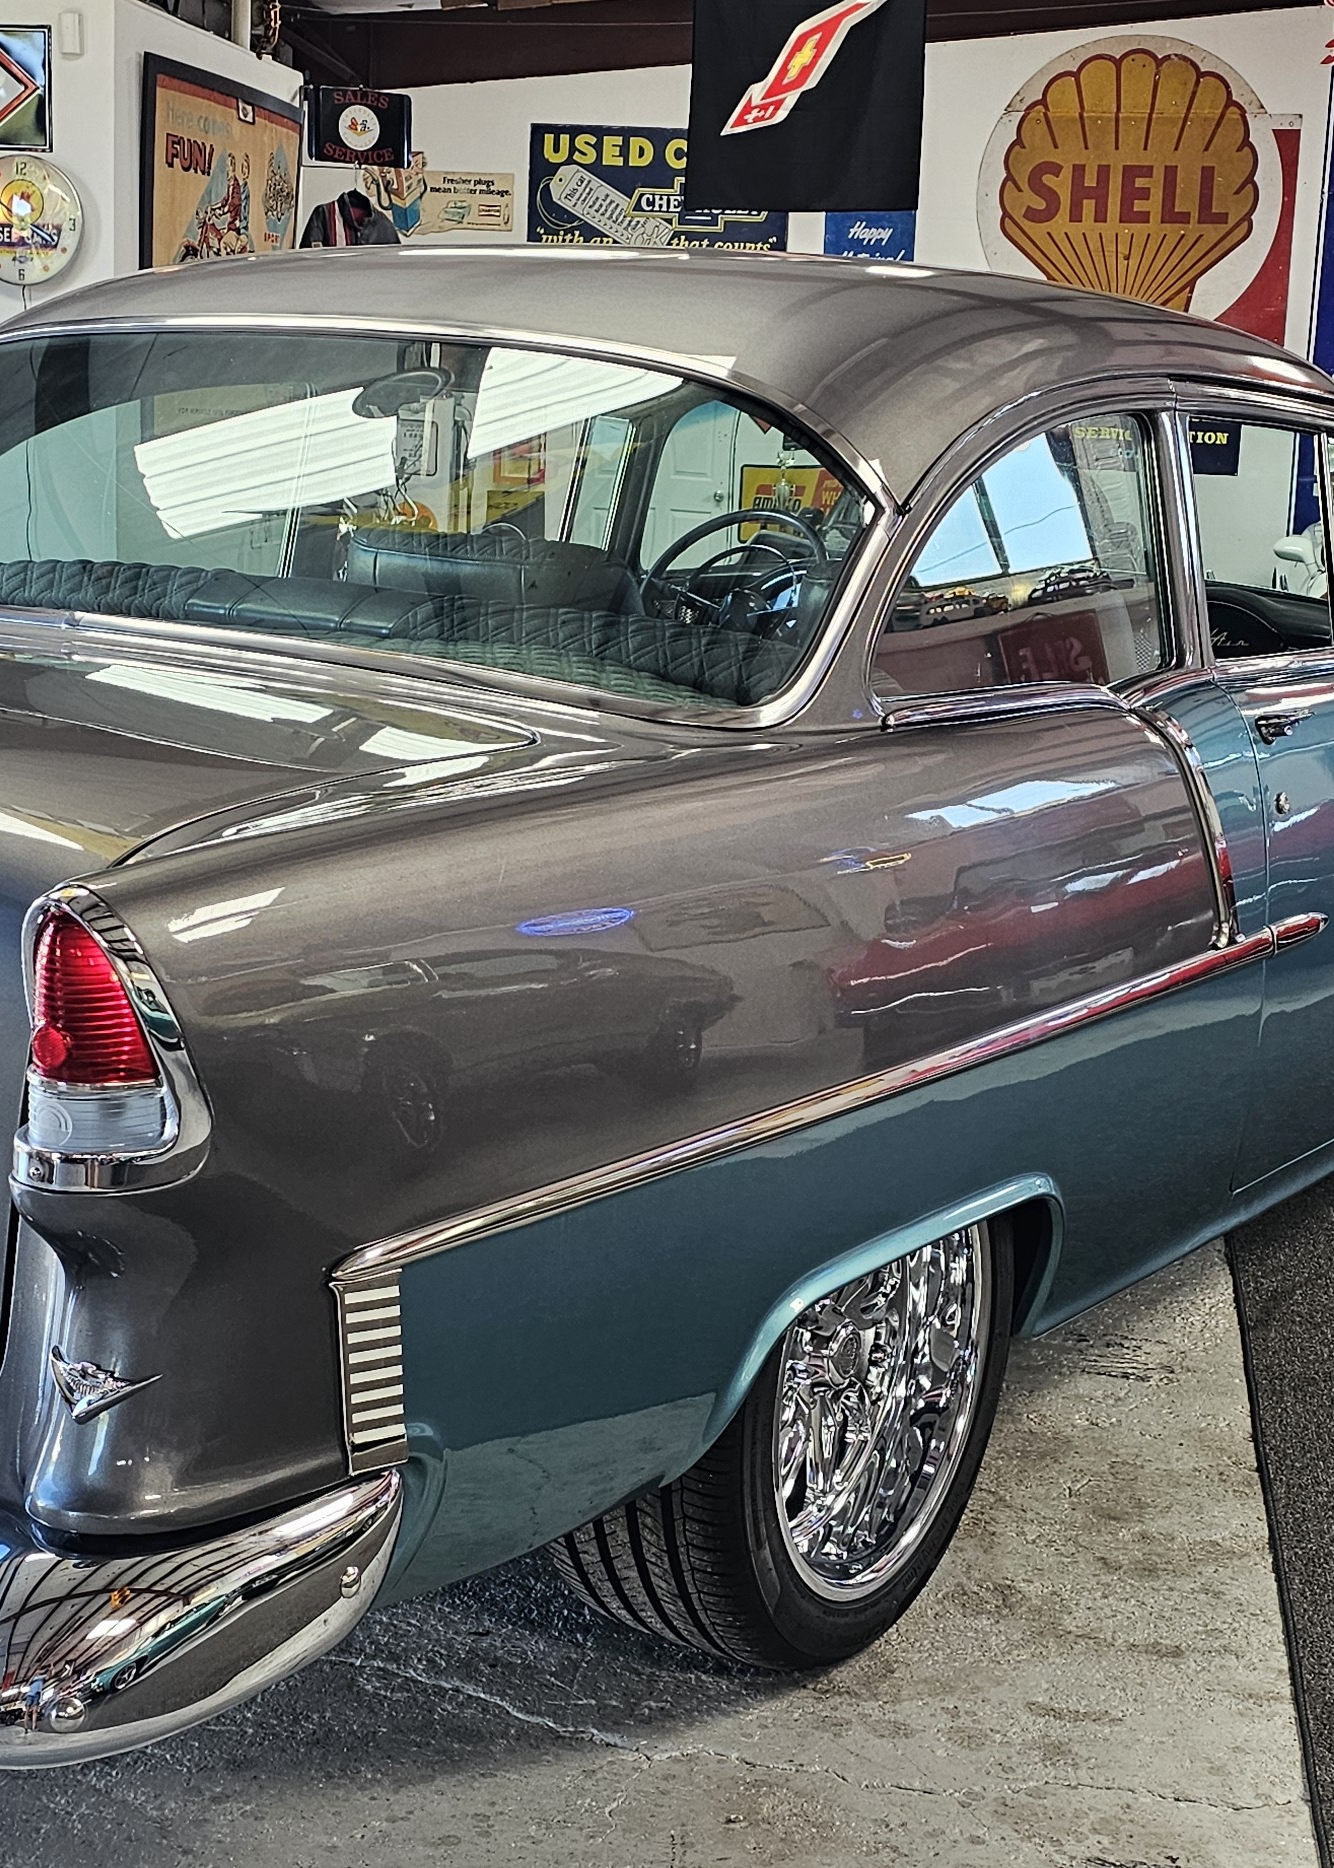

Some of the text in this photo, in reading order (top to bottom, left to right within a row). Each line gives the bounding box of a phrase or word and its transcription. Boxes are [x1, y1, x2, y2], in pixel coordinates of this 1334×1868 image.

[333, 90, 389, 109] SALES
[166, 132, 214, 177] FUN!
[323, 142, 396, 163] SERVICE
[543, 133, 655, 167] USED
[15, 161, 27, 176] 12
[429, 186, 452, 194] mean
[478, 187, 512, 198] mileage.
[443, 176, 495, 189] Fresher plugs
[563, 187, 579, 202] This
[575, 175, 587, 187] car
[1022, 160, 1230, 225] SHELL
[69, 217, 76, 231] 3
[848, 221, 893, 246] Happy
[18, 268, 25, 281] 6
[1073, 426, 1135, 441] SERVIC
